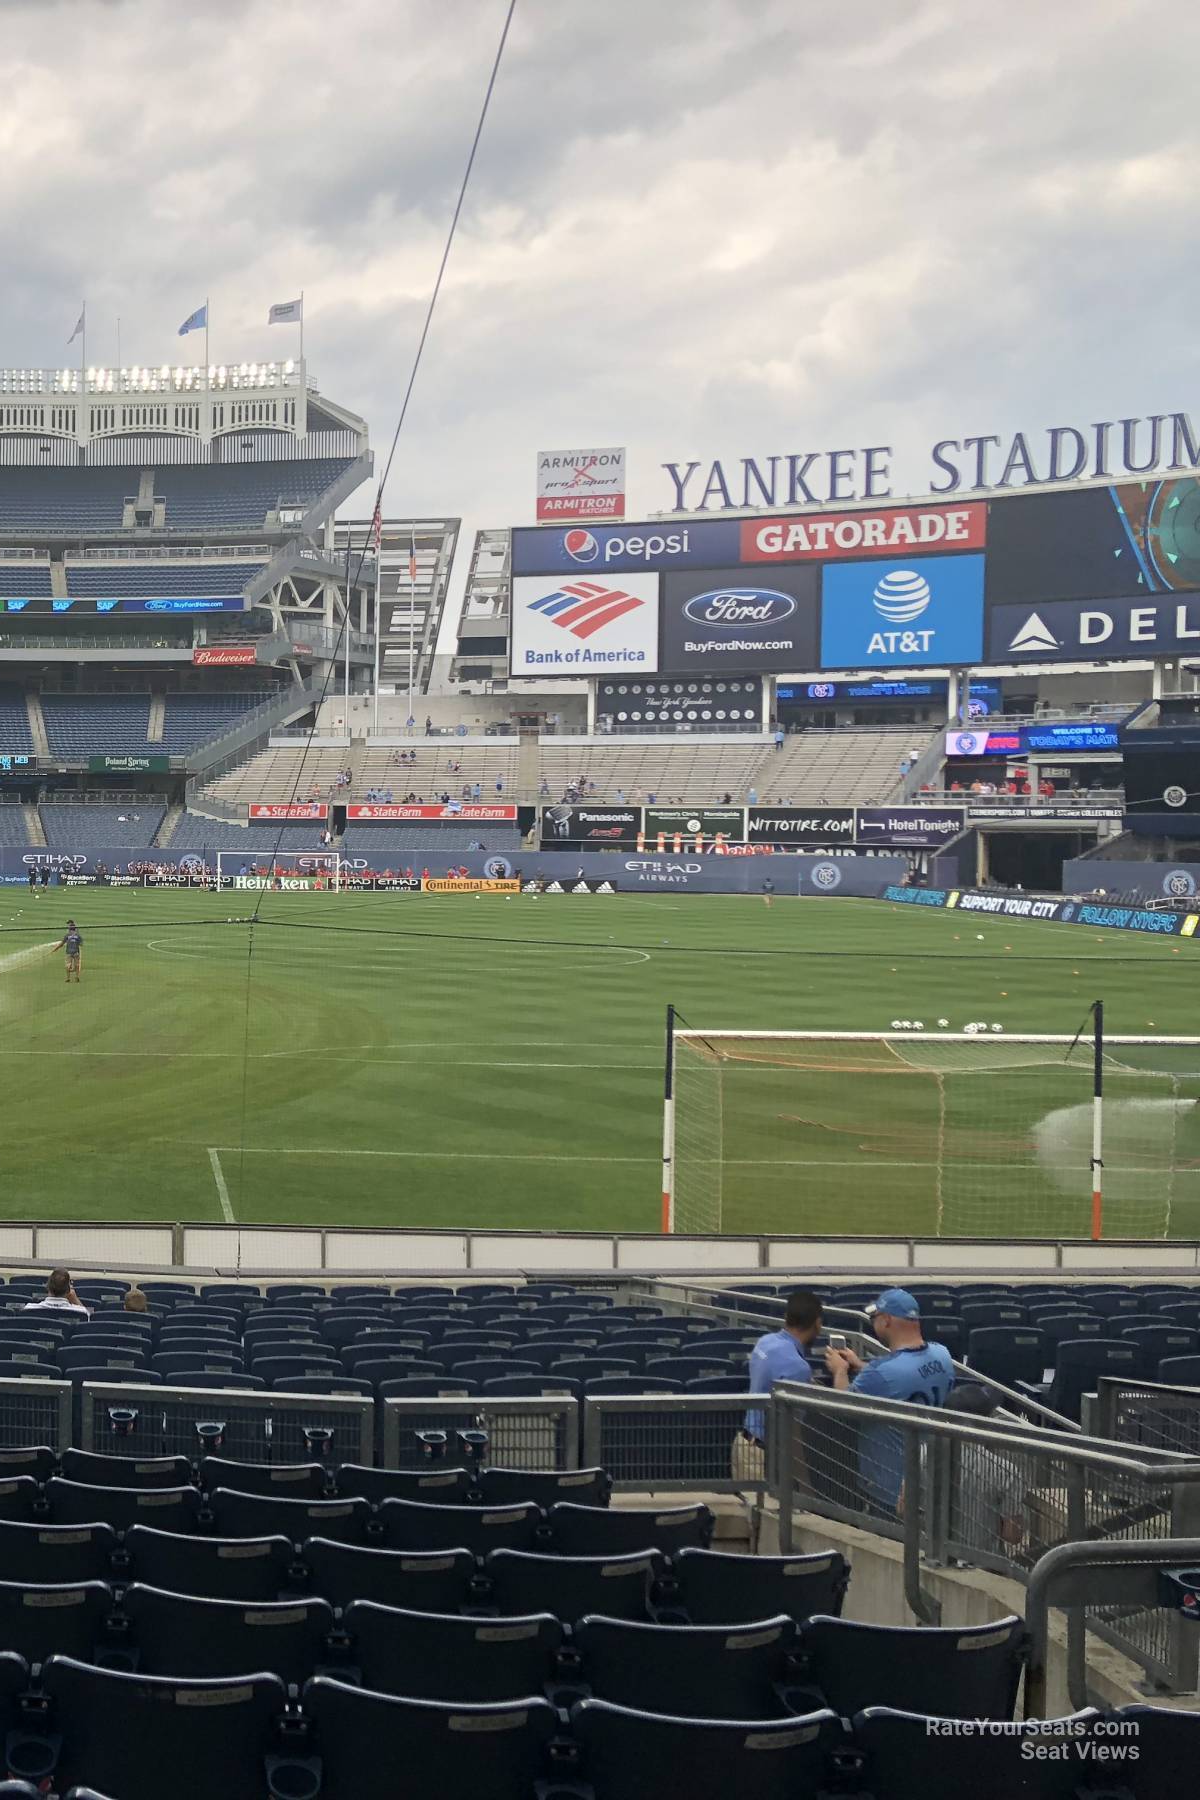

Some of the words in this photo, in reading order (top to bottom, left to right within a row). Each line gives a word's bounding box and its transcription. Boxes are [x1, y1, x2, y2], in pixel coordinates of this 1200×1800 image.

[540, 454, 622, 469] ARMITRON
[661, 446, 895, 513] YANKEE
[544, 497, 616, 510] ARMITRON
[756, 511, 969, 554] GATORADE
[605, 529, 688, 561] pepsi
[8, 601, 25, 610] SAP
[53, 602, 68, 611] SAP
[97, 602, 112, 611] SAP
[149, 601, 167, 609] Ford
[705, 594, 774, 620] Ford
[684, 639, 793, 653] BuyFordNow.com
[866, 630, 936, 654] AT&T
[194, 649, 255, 665] Budweiser
[525, 649, 563, 664] Bank
[565, 649, 581, 663] of
[582, 648, 645, 663] America
[661, 697, 680, 709] York
[1053, 727, 1092, 735] WELCOME
[1094, 727, 1105, 735] TO
[1029, 735, 1084, 747] TODAY'S
[14, 756, 29, 764] WEB
[105, 757, 127, 767] Poland
[127, 757, 150, 767] Spring
[578, 812, 635, 822] Panasonic
[748, 815, 853, 834] NITTOTIRE.COM
[888, 818, 960, 834] HotelTonight
[22, 854, 87, 865] ETIHAD
[299, 857, 368, 869] ETIHAD
[625, 861, 702, 873] ETIHAD
[67, 874, 96, 882] BlackBerry
[234, 876, 310, 890] Heinken
[638, 874, 688, 883] AIRWAYS
[425, 879, 483, 892] Continental
[493, 881, 518, 890] TIRE
[960, 894, 1004, 912] SUPPORT
[1003, 899, 1032, 915] YOUR
[1031, 902, 1059, 918] CITY
[1077, 906, 1131, 927] FOLLOW
[1130, 911, 1178, 932] NYCFC
